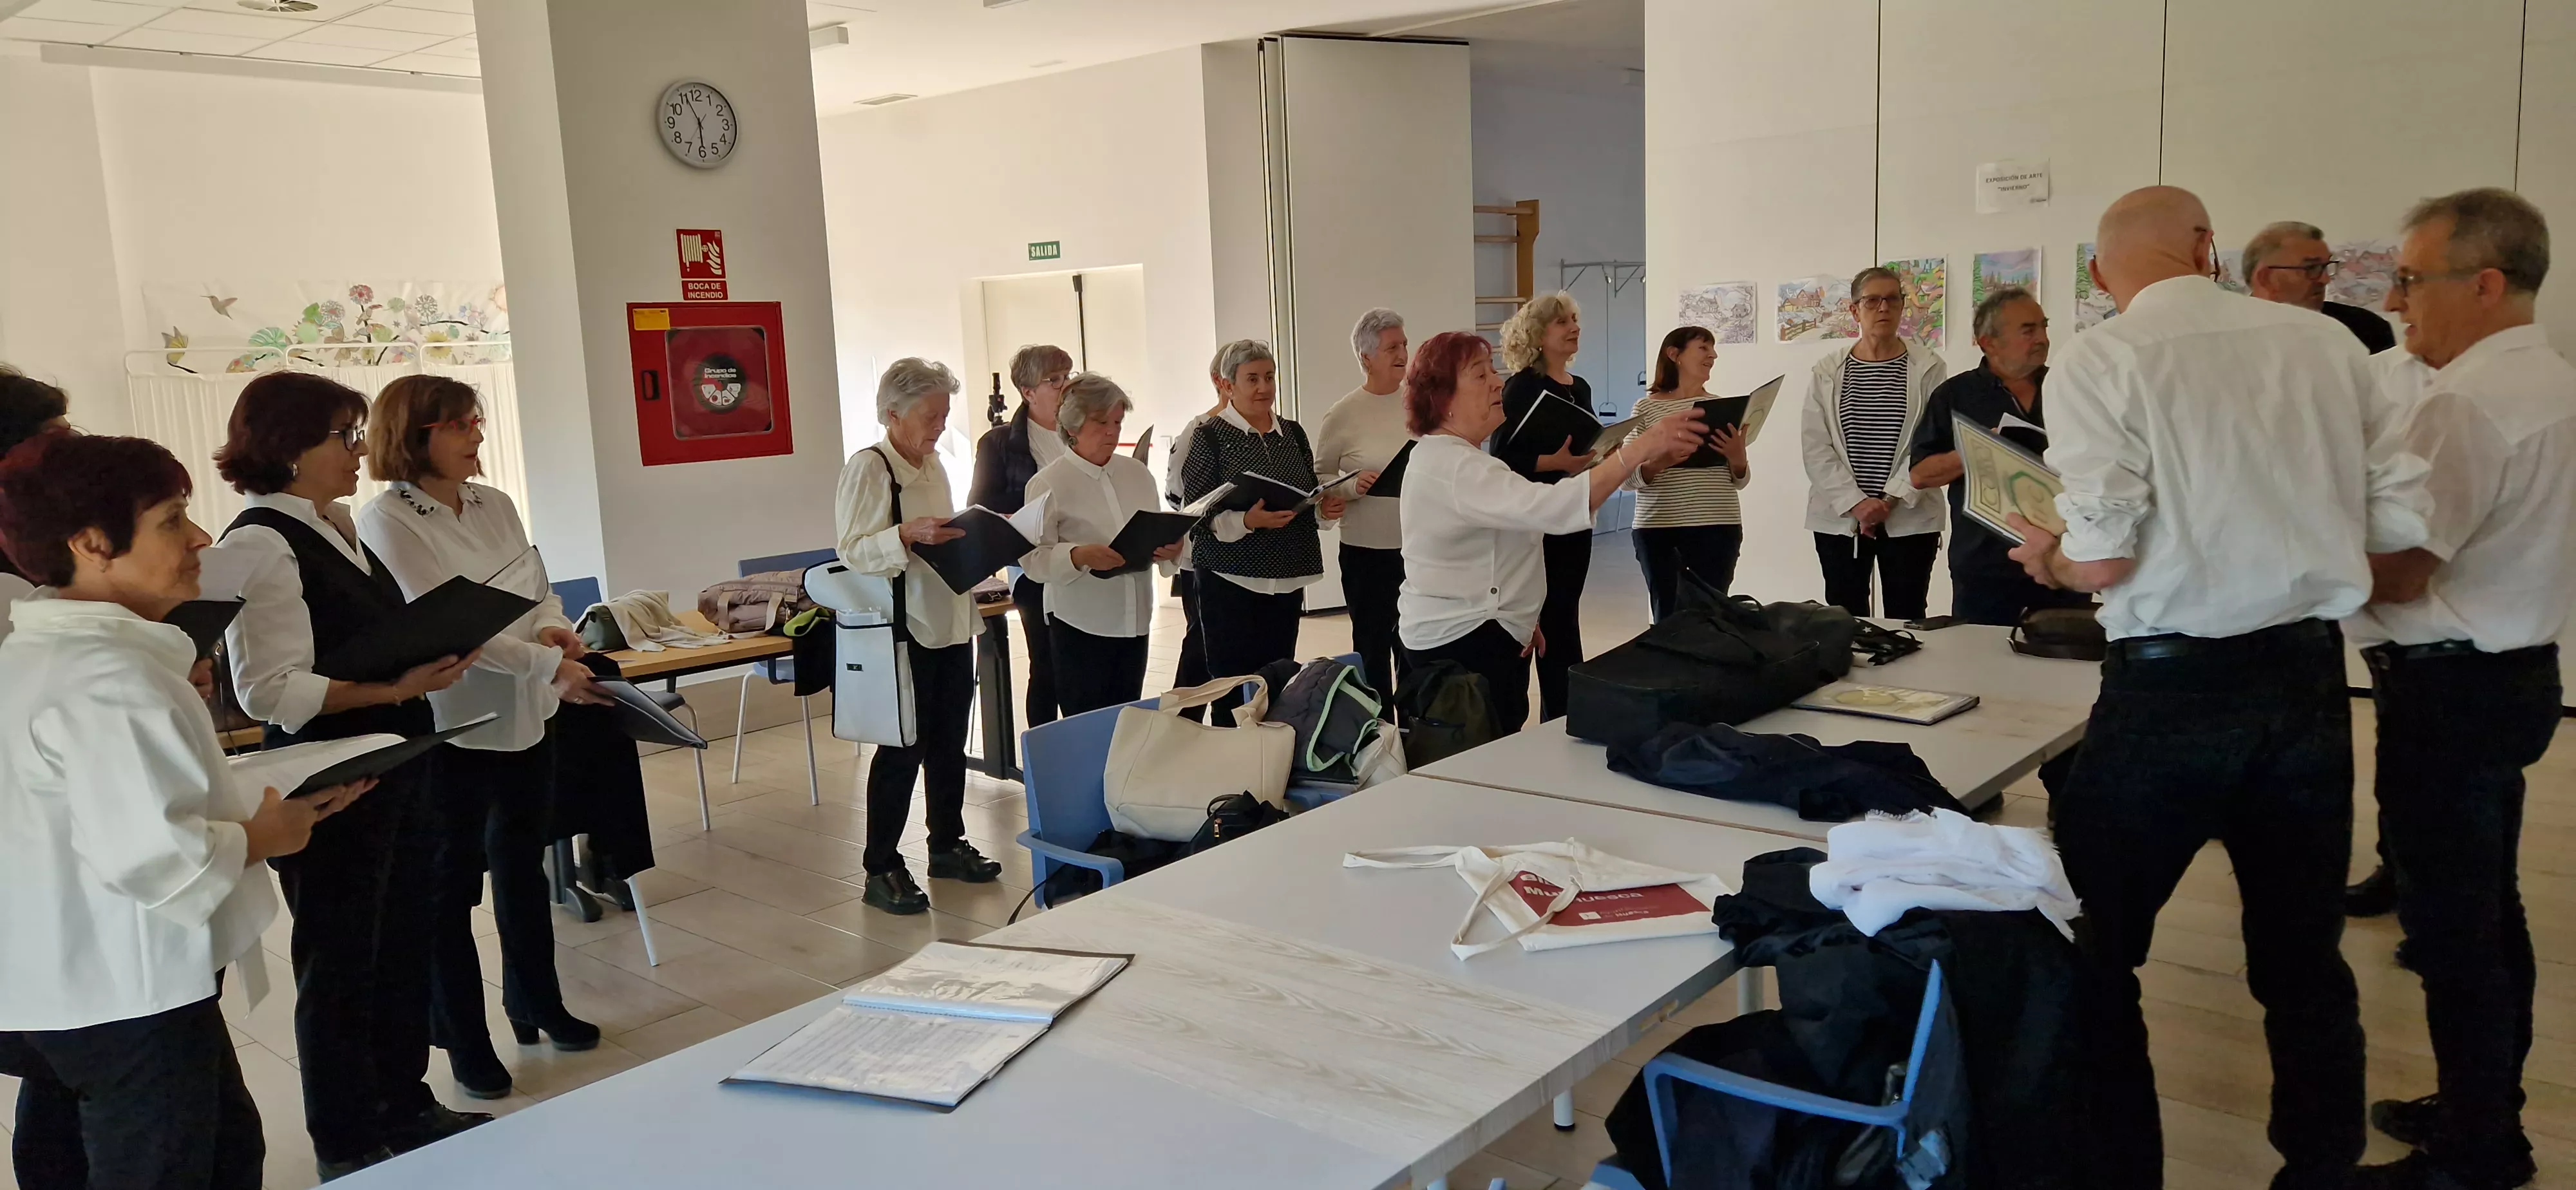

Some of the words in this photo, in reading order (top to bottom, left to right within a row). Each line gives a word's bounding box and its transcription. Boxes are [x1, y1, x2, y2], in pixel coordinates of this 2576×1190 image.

[678, 92, 688, 104] 11
[689, 90, 703, 102] 12
[706, 94, 712, 106] 1
[670, 103, 682, 116] 10
[715, 104, 724, 117] 2
[667, 116, 675, 129] 9
[722, 118, 730, 131] 3
[674, 131, 682, 144] 8
[719, 133, 727, 145] 4
[685, 141, 692, 154] 7
[698, 146, 706, 158] 6
[711, 142, 719, 155] 5
[1031, 245, 1057, 258] SALIDA
[1523, 886, 1561, 896] Mu
